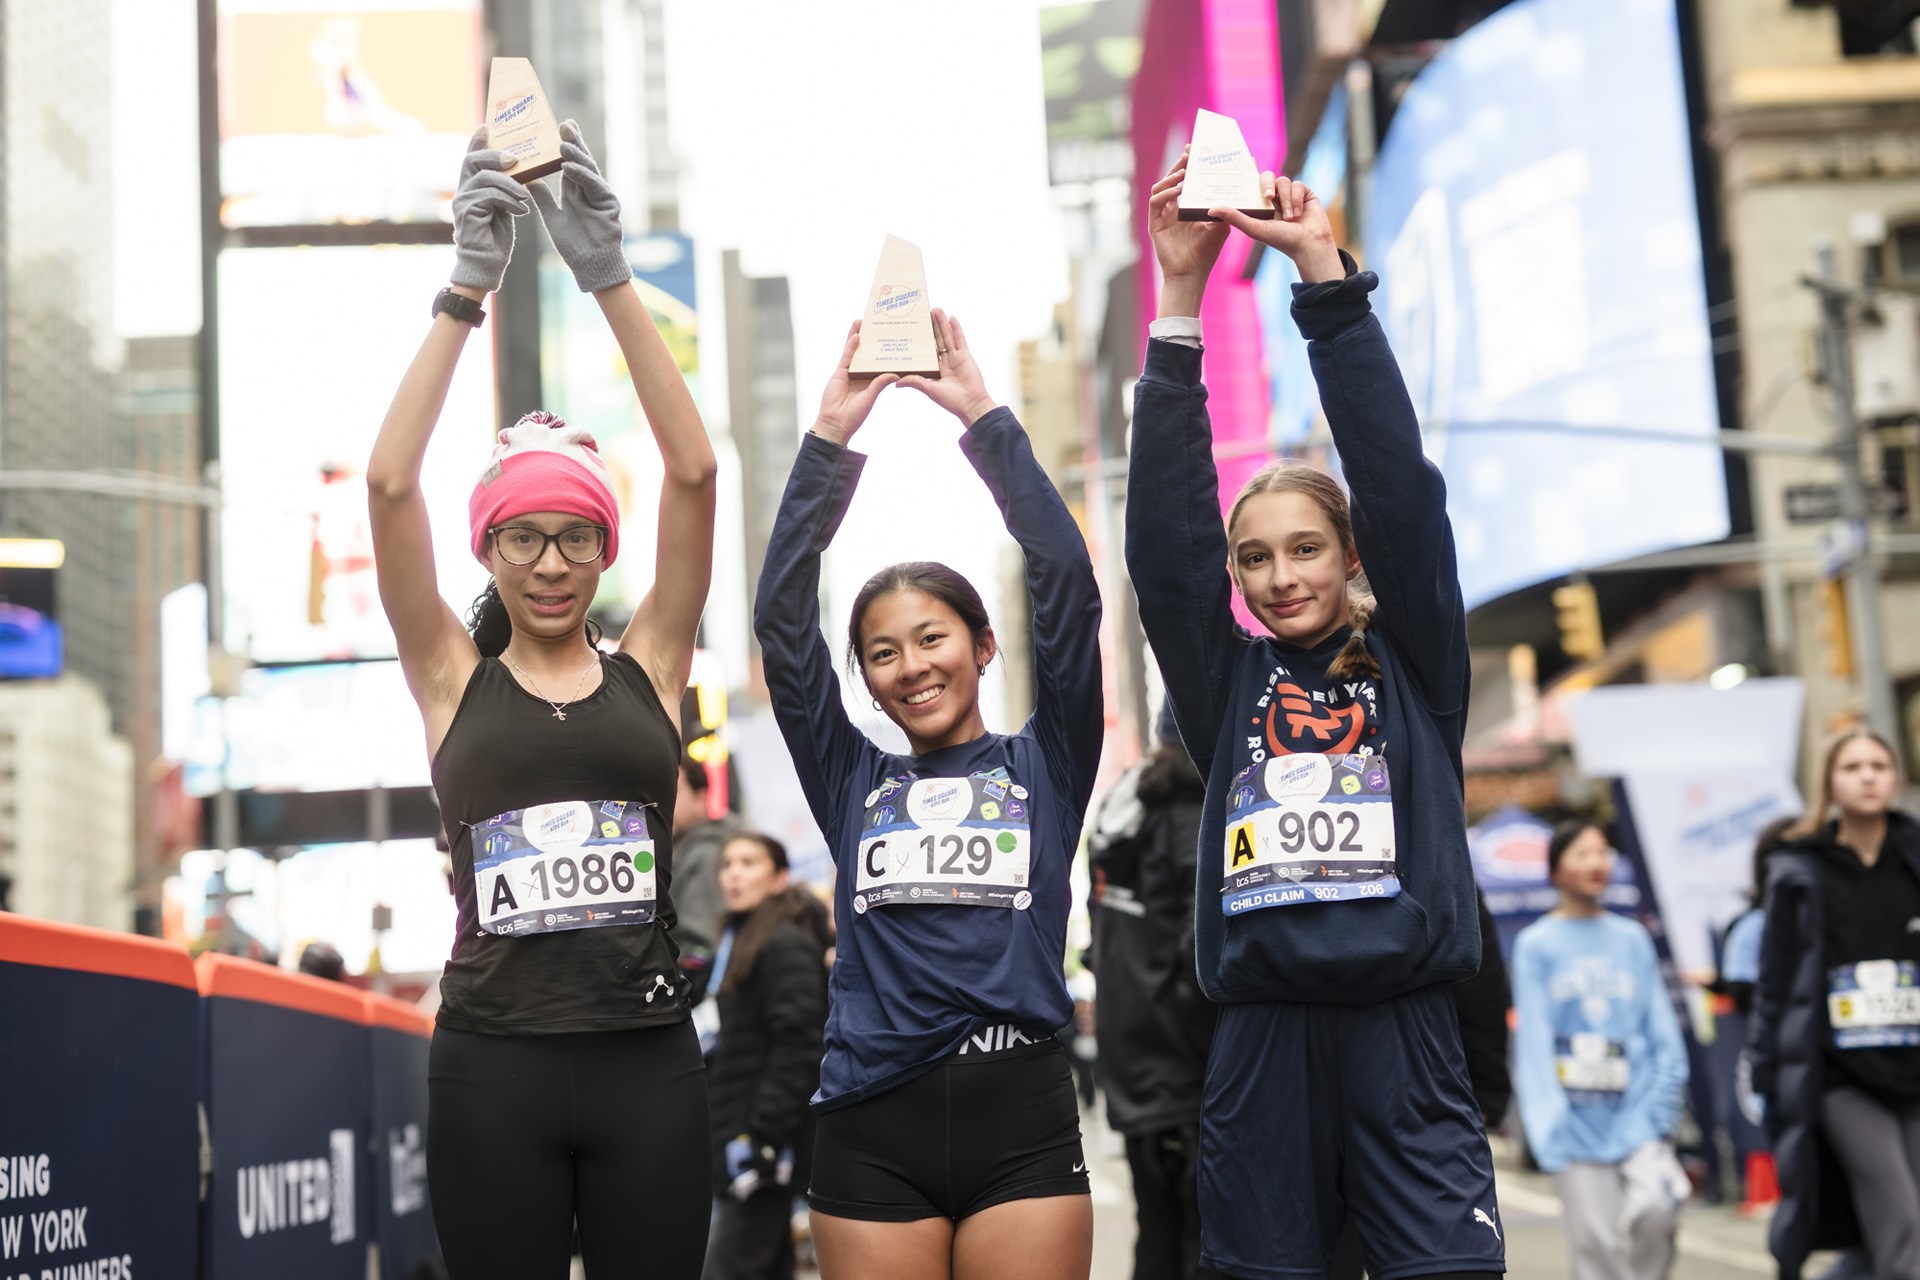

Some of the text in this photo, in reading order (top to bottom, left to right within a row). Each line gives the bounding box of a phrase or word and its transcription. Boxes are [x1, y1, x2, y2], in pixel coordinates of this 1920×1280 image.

[494, 95, 534, 124] TIMES SQUARE
[875, 289, 919, 308] TIMES SQUARE
[886, 301, 898, 311] KIDS
[1247, 736, 1266, 763] RO
[1280, 761, 1316, 782] TIMES SQUARE
[922, 787, 958, 805] TIMES SQUARE
[540, 809, 576, 830] TIMES SQUARE
[1232, 810, 1363, 867] A 902
[866, 840, 887, 878] C
[919, 834, 993, 876] 129
[490, 851, 635, 916] A 1986
[1230, 895, 1263, 911] CHILD
[1268, 889, 1305, 903] CLAIM
[1314, 887, 1340, 899] 902
[958, 1024, 1051, 1055] NIK
[237, 1157, 331, 1239] UNITED
[30, 1206, 88, 1255] YORK
